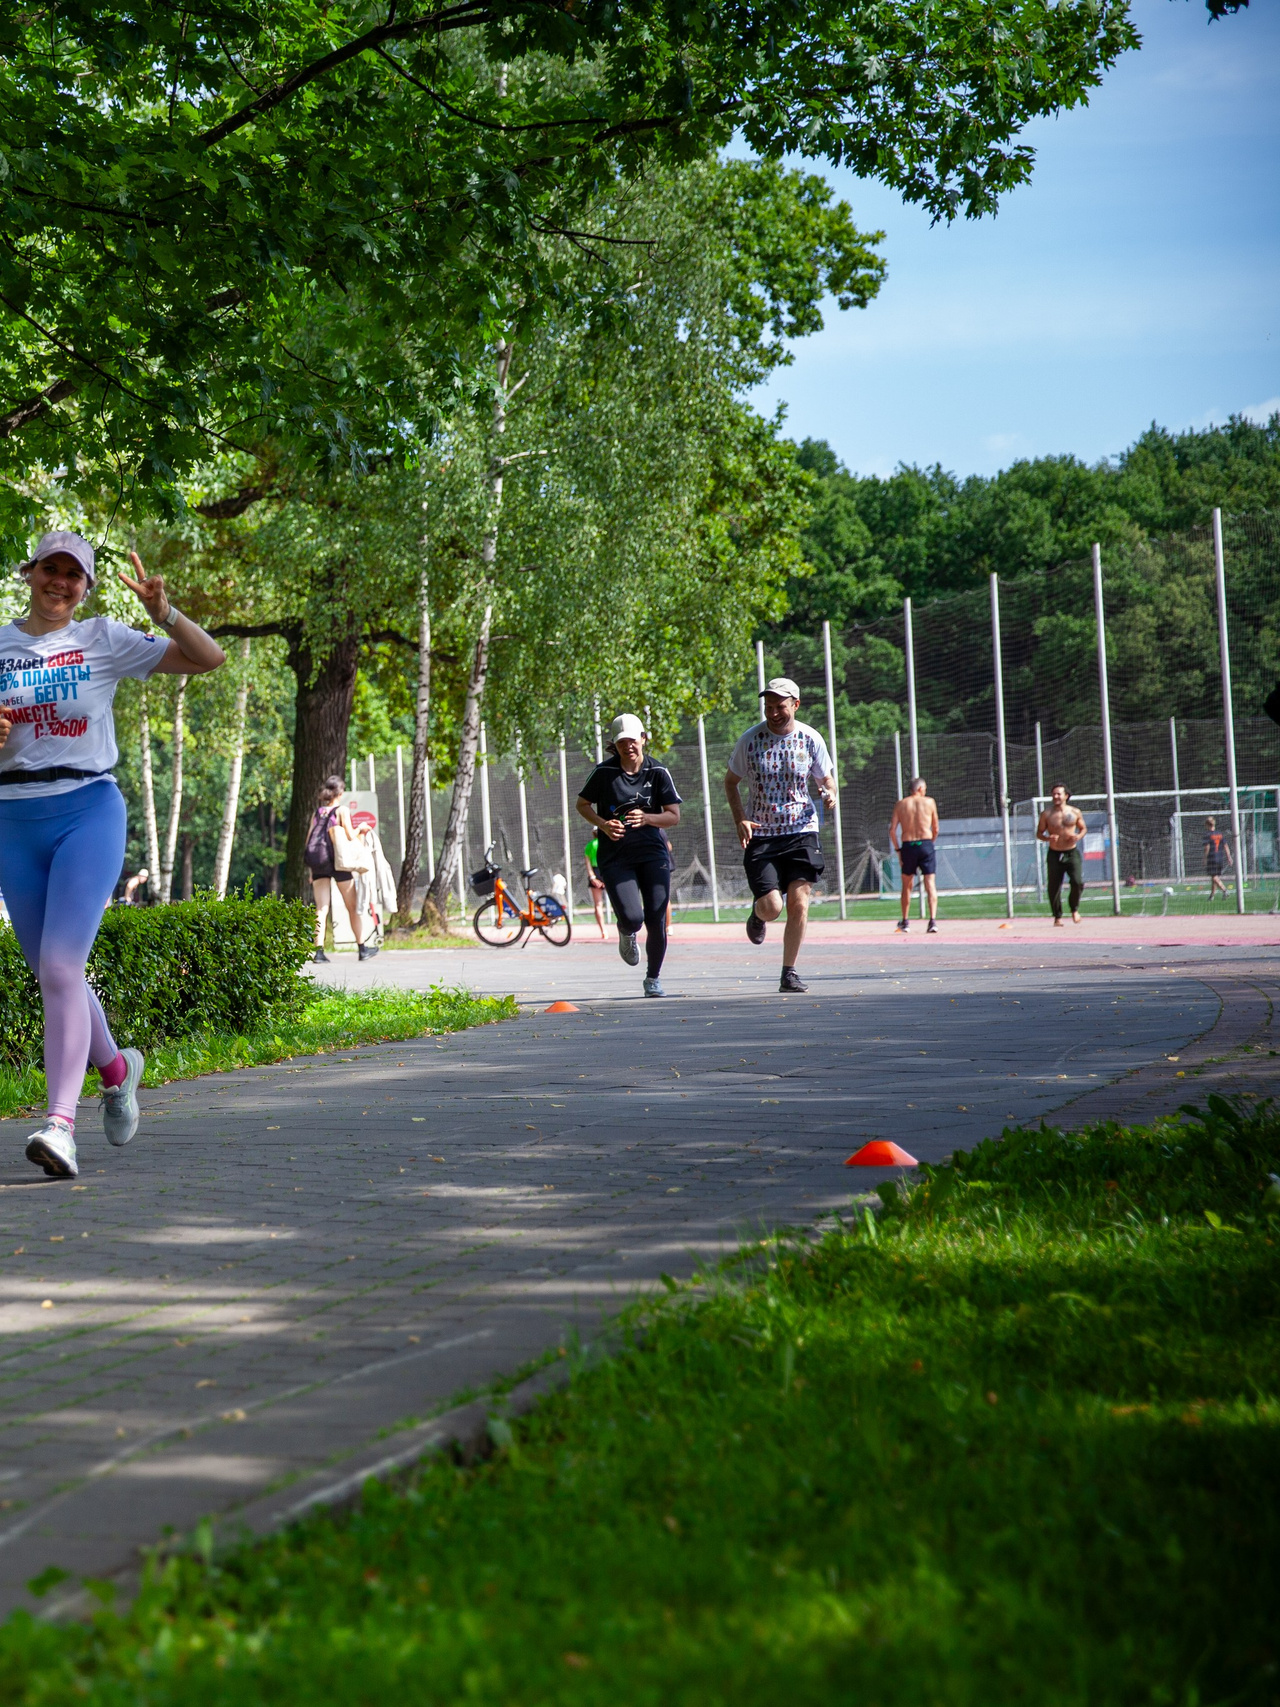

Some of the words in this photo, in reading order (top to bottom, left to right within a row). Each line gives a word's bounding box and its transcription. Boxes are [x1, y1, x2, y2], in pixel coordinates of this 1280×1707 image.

[47, 649, 84, 668] 2025
[22, 665, 91, 687] ПЛАНЕТЫ
[34, 682, 78, 704] БЕГУТ
